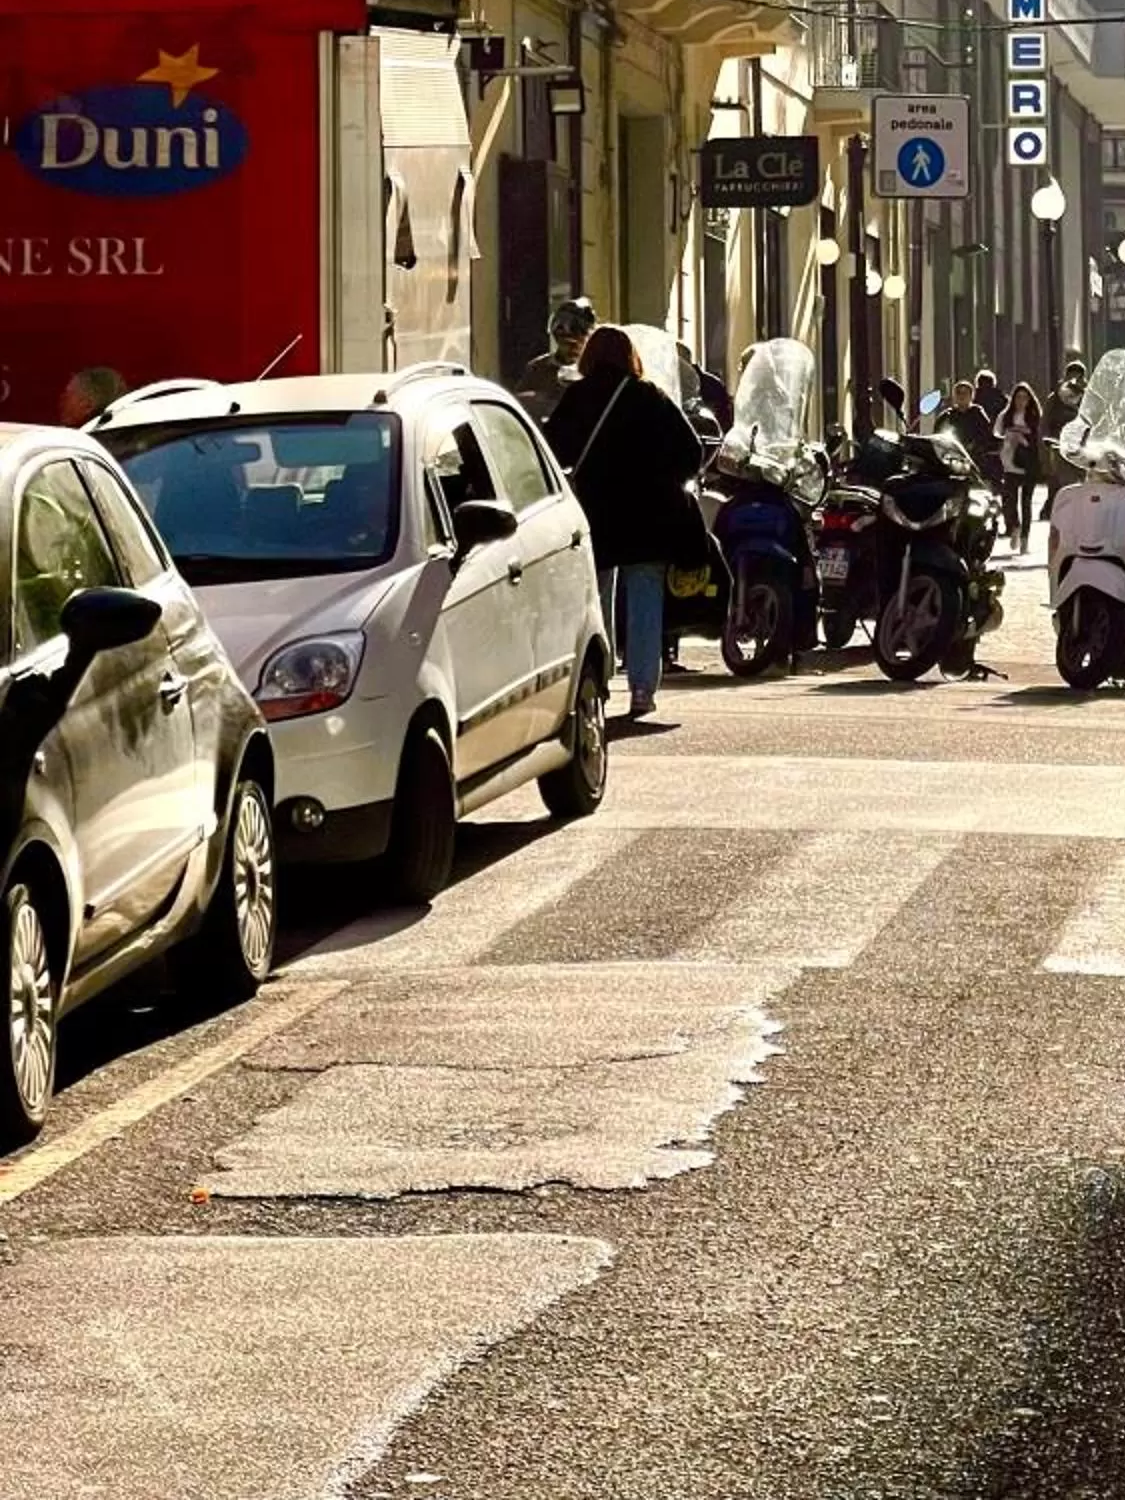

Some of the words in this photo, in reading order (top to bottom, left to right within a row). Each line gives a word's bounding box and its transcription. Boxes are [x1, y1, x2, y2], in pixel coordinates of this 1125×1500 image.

[907, 104, 937, 115] area
[891, 117, 954, 131] pedonale
[39, 108, 220, 170] Duni
[716, 153, 750, 179] La
[66, 236, 164, 276] SRL
